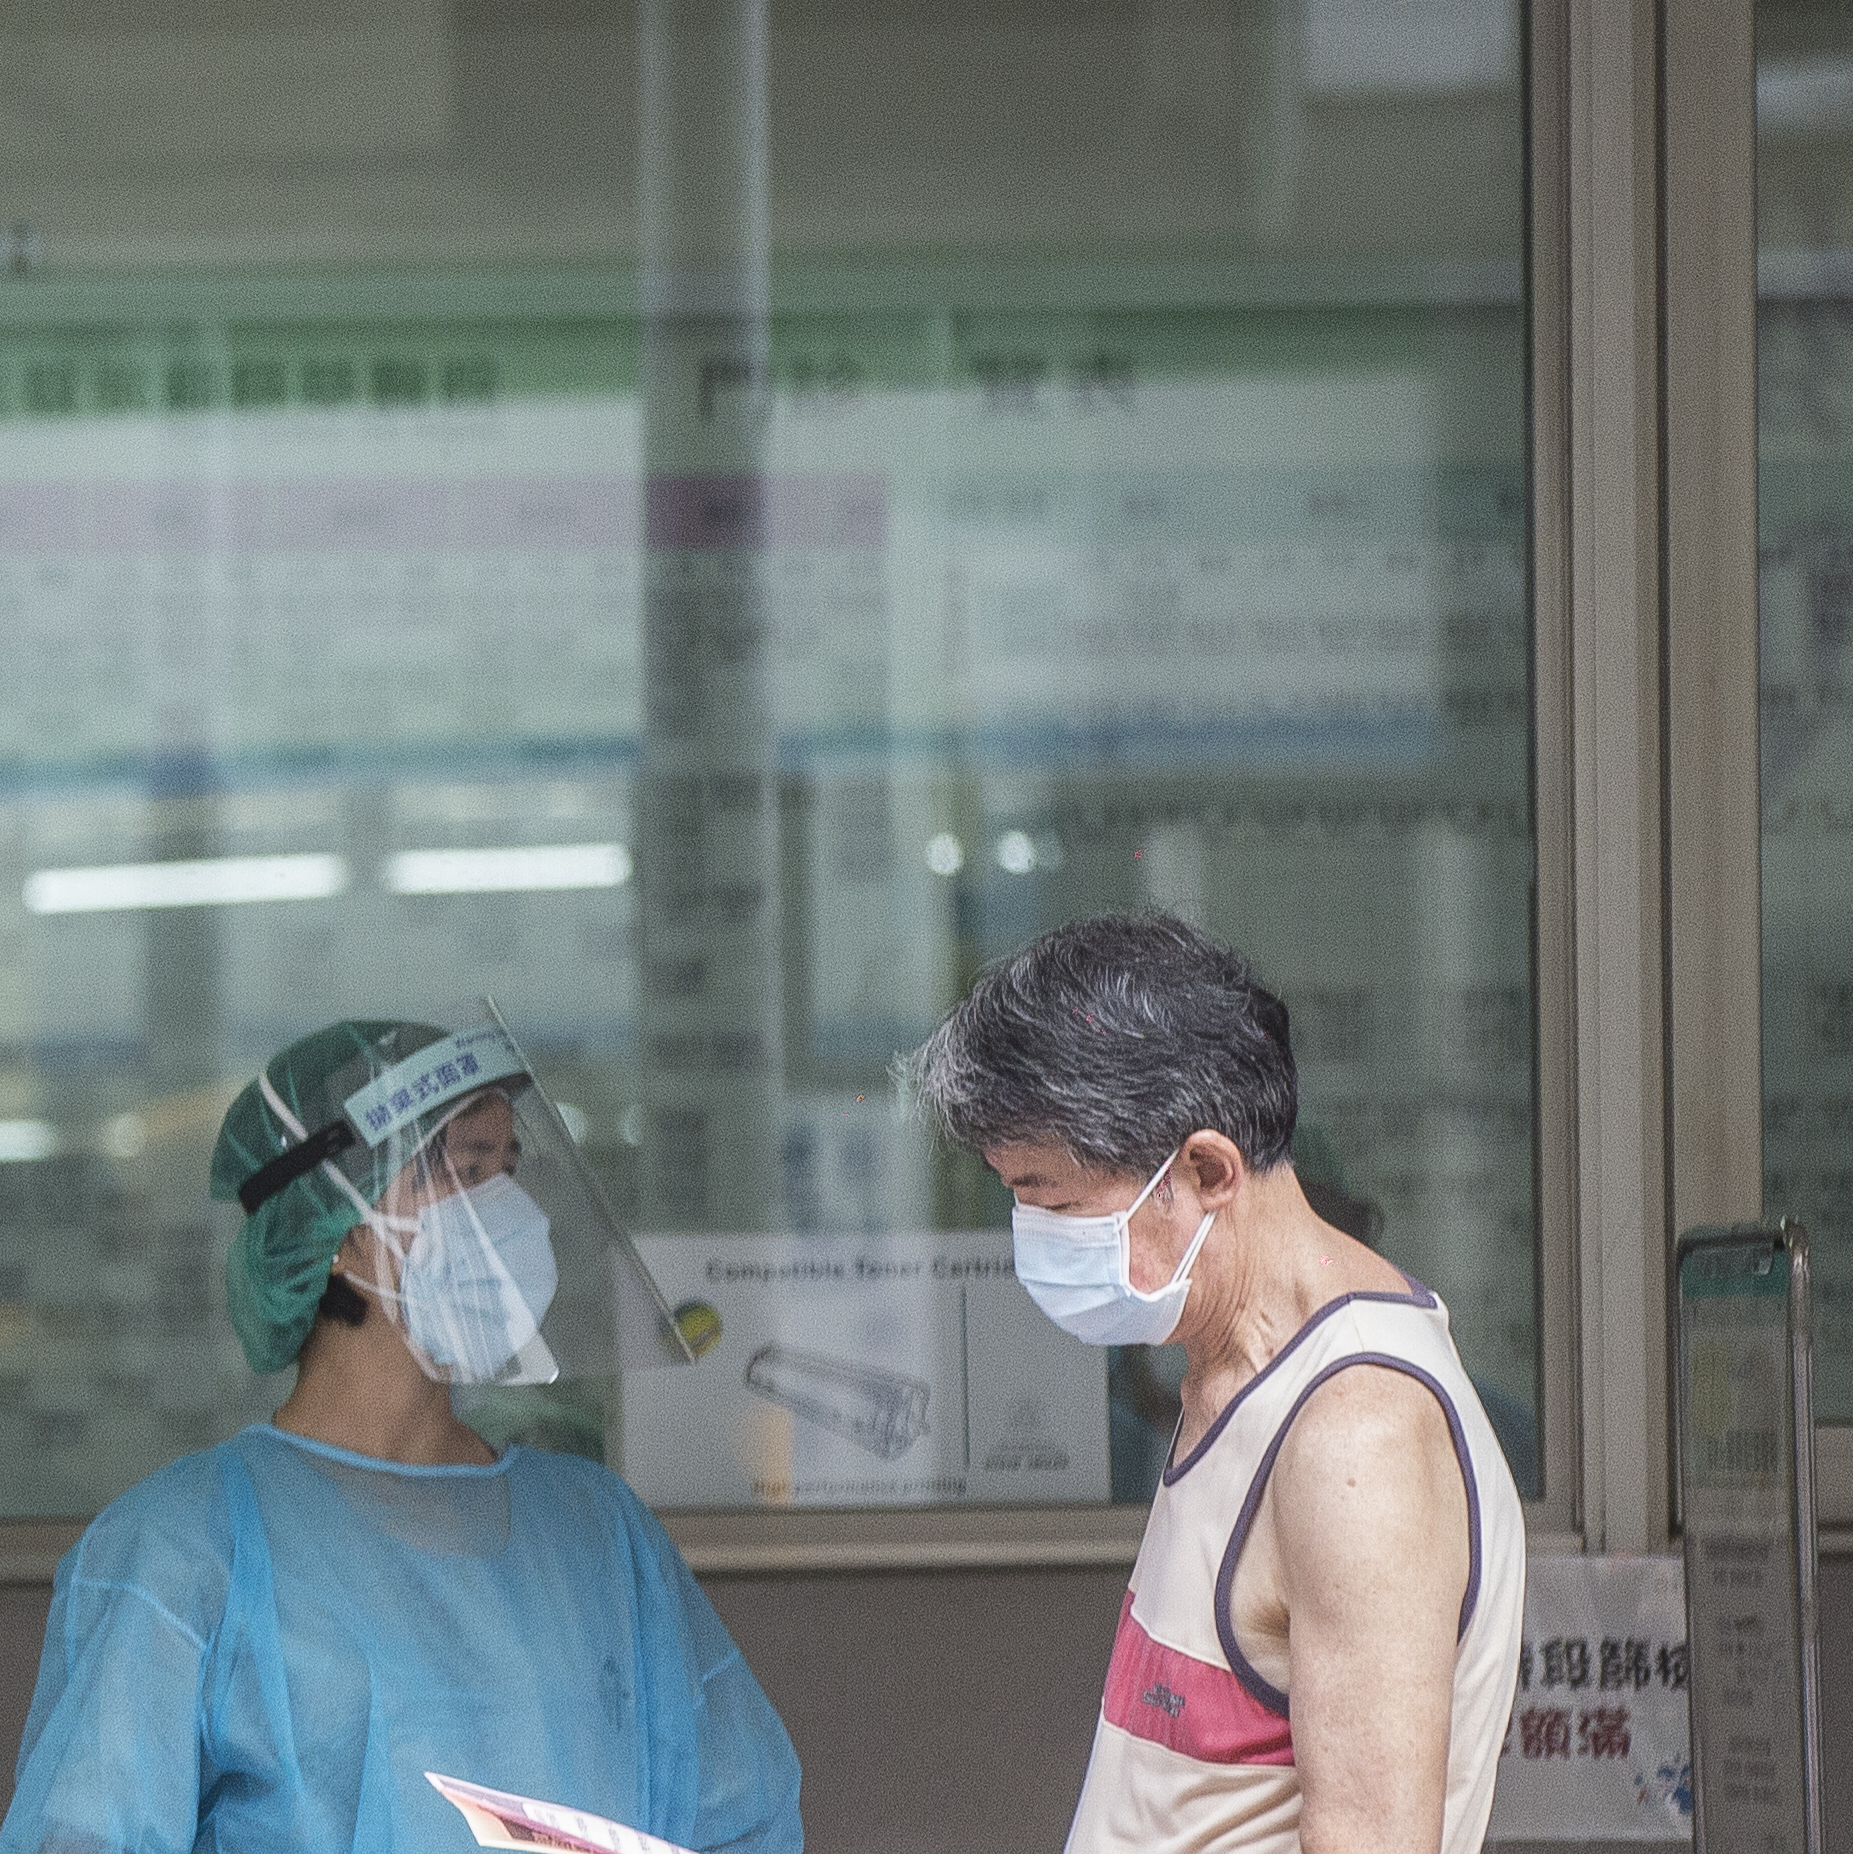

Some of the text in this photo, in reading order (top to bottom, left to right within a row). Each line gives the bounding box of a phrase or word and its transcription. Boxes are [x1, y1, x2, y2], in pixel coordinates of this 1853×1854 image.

[704, 1256, 842, 1285] Compatible
[854, 1253, 920, 1281] Toner
[1501, 1705, 1631, 1760] 額滿
